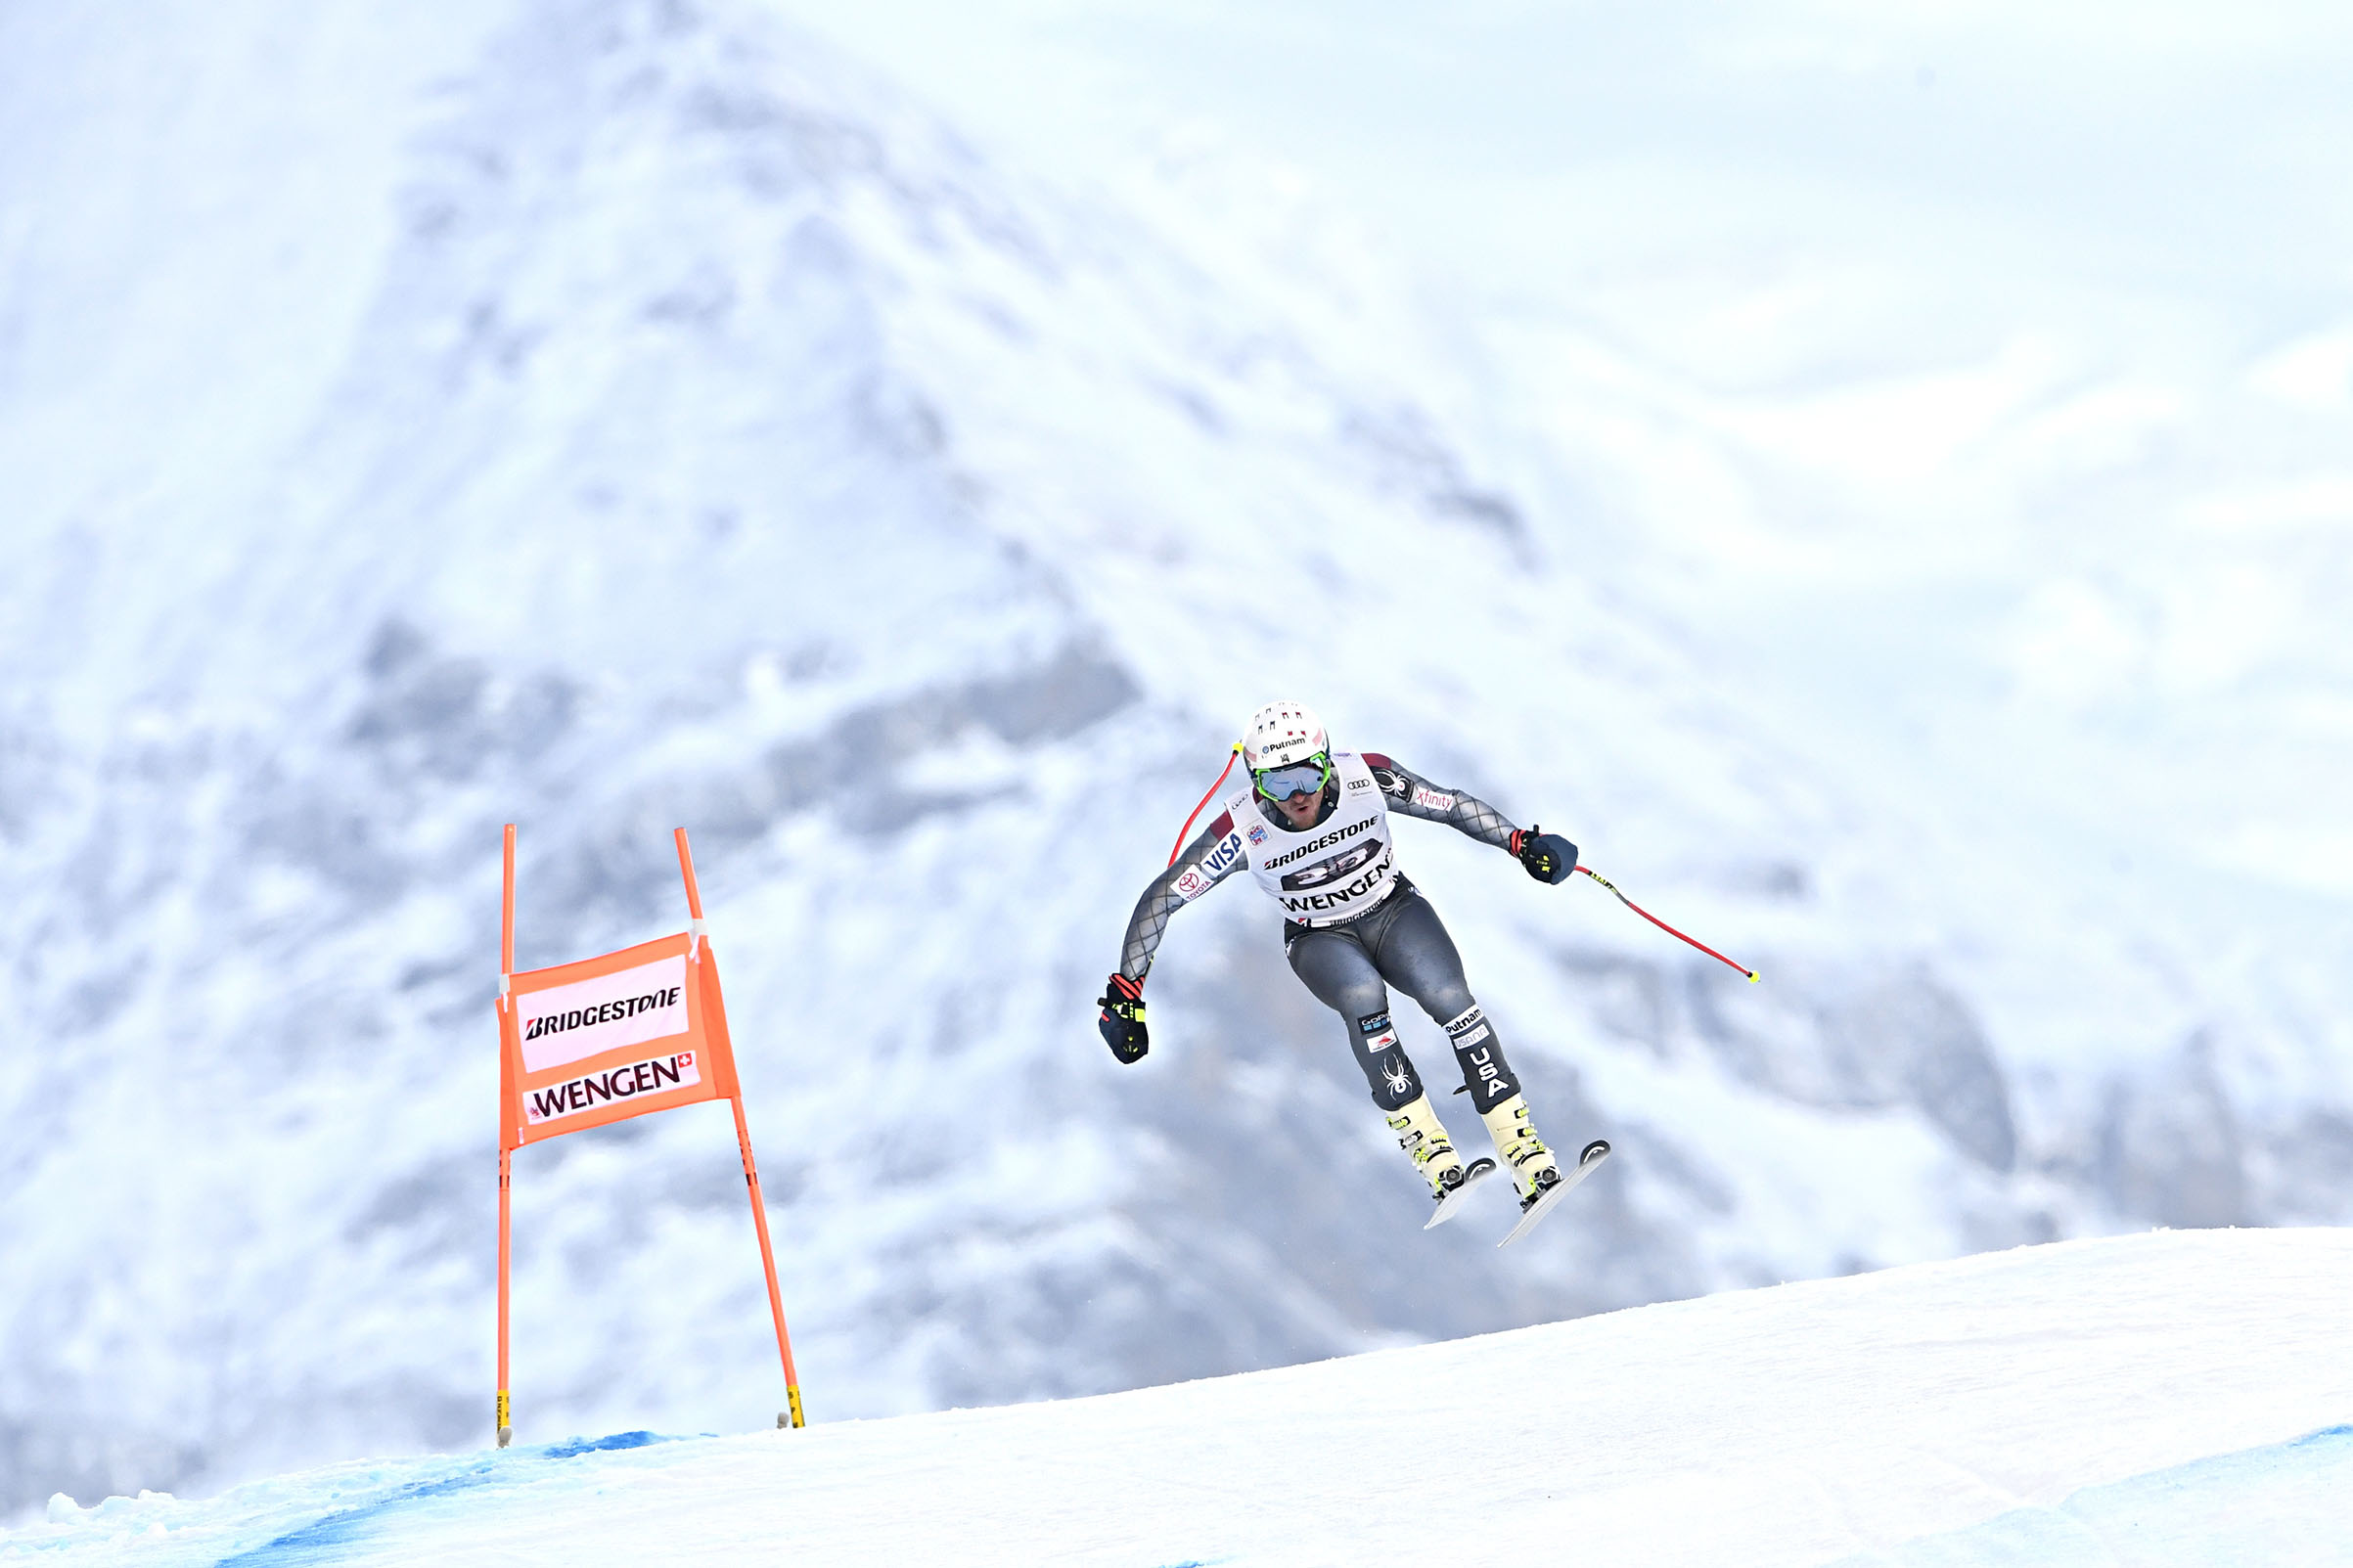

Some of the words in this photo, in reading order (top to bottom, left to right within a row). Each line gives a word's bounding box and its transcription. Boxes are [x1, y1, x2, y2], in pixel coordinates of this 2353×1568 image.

[1269, 738, 1306, 751] Putnam
[1417, 790, 1453, 811] xfinity
[1203, 832, 1243, 872] VISA
[1263, 815, 1380, 871] BRIDGESTONE
[1186, 880, 1212, 901] TOYOTA
[1279, 853, 1390, 913] WENGEN
[524, 986, 681, 1041] BRIDGESTONE
[1445, 1008, 1482, 1035] Putnam
[1455, 1027, 1487, 1048] USANA
[533, 1056, 681, 1117] WENGEN
[1470, 1046, 1510, 1098] USA
